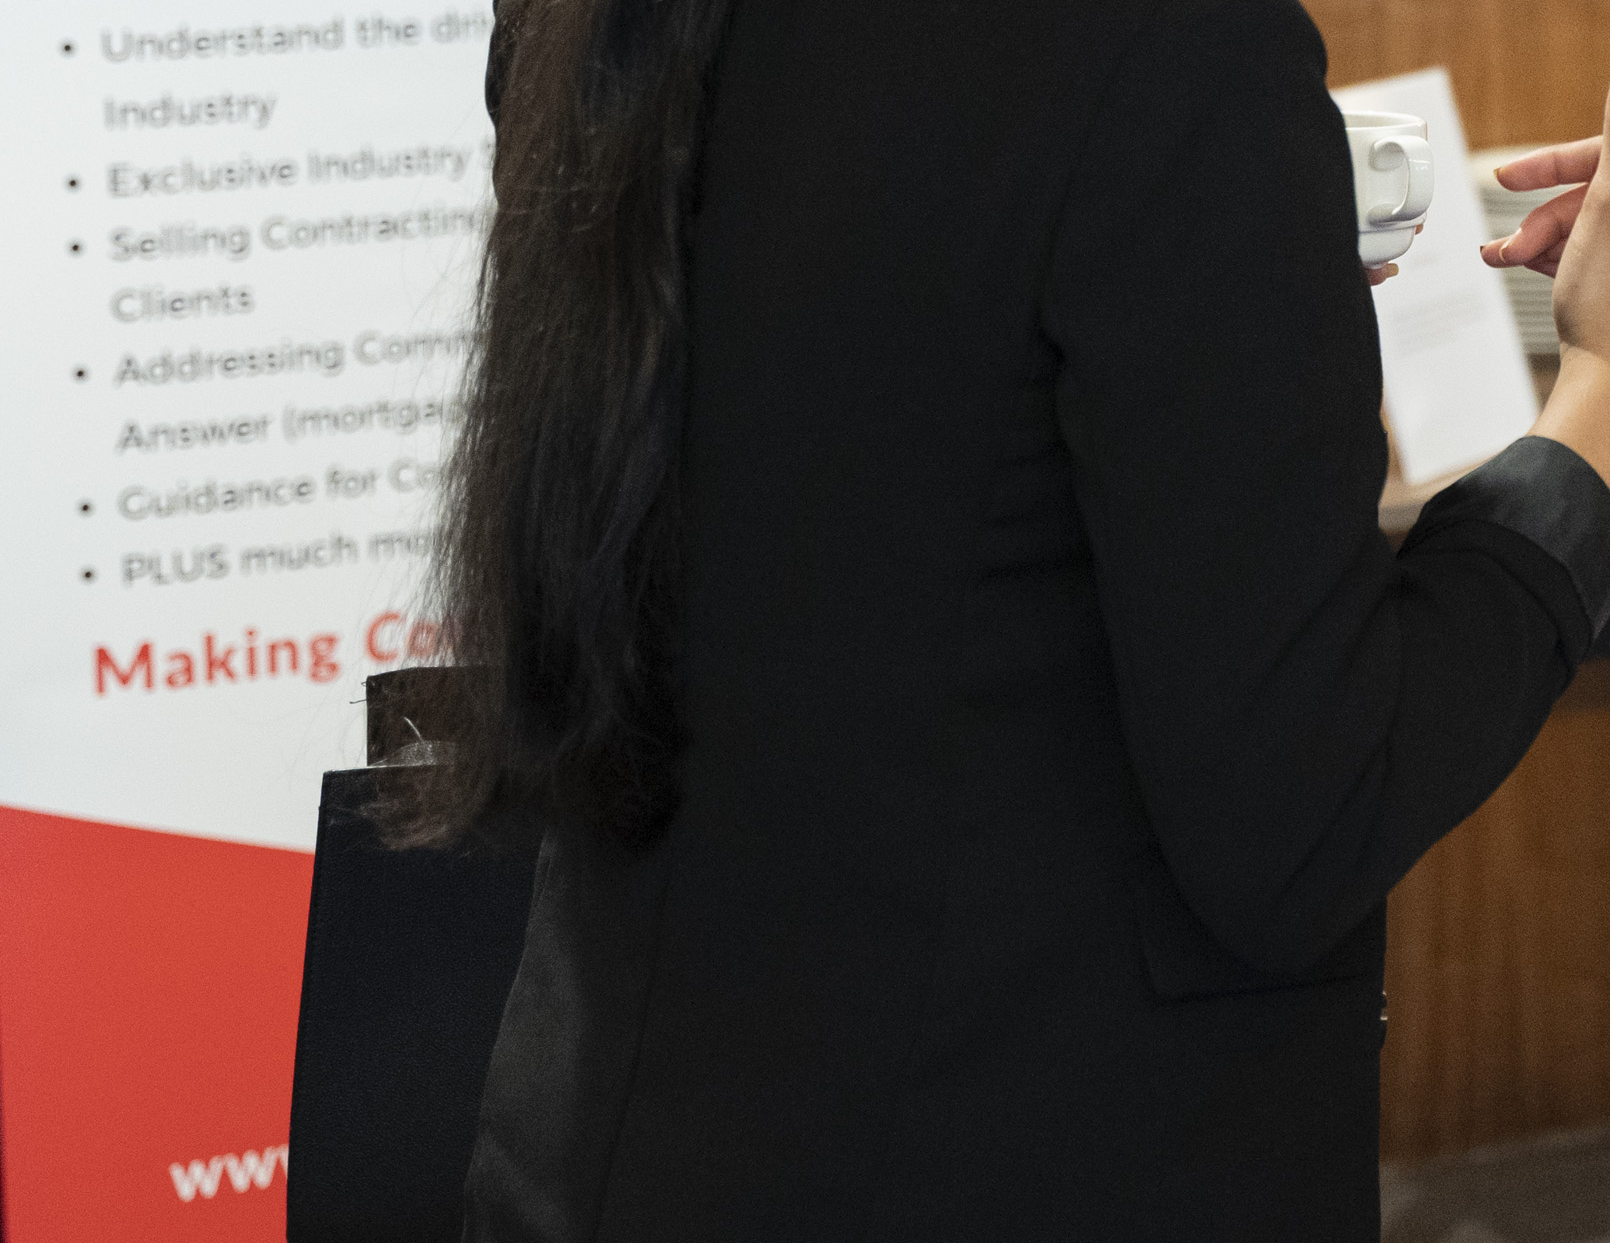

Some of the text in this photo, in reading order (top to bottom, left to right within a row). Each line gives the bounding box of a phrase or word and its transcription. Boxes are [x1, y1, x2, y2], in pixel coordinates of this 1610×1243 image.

[101, 13, 345, 62] Understand
[355, 11, 423, 49] the
[104, 91, 277, 130] Industry
[108, 155, 298, 197] Exclusive
[307, 143, 472, 182] Industry
[109, 220, 251, 262] Selling
[110, 285, 255, 324] Clients
[116, 337, 345, 386] Addressing
[117, 417, 268, 455] Answer
[118, 474, 316, 521] Guidance
[327, 464, 377, 497] for
[122, 542, 231, 587] PLUS
[240, 533, 359, 576] much
[92, 626, 342, 696] Making
[169, 1144, 288, 1202] ww
